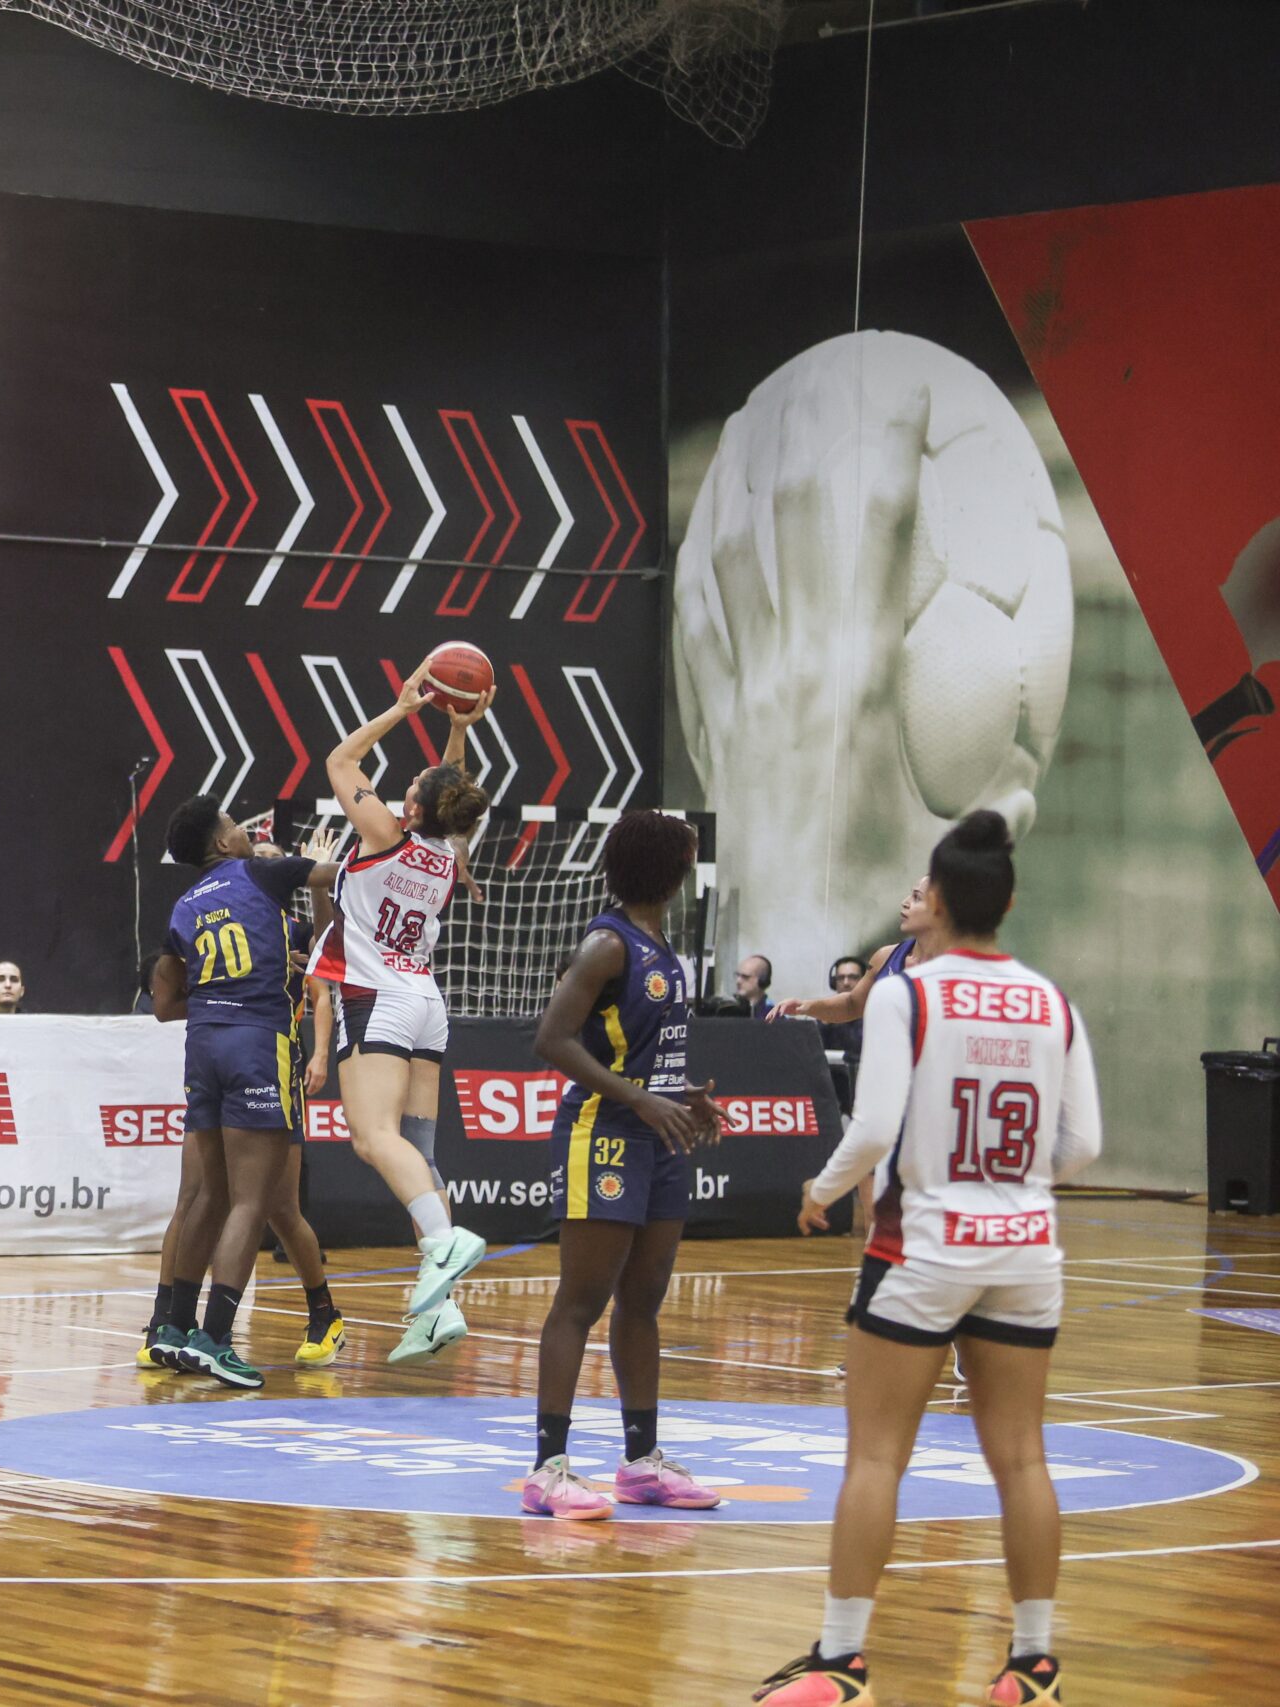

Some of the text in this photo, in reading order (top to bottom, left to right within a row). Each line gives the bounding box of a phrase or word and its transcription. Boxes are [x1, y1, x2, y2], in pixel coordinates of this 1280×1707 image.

[384, 872, 428, 900] ALINE
[205, 908, 231, 924] SOUZA
[374, 897, 426, 955] 12
[195, 922, 252, 985] 20
[952, 982, 1041, 1021] SESI
[967, 1036, 1031, 1067] MIKA
[308, 1104, 351, 1140] ES
[479, 1078, 573, 1138] SE
[727, 1100, 805, 1133] SESI
[114, 1109, 186, 1144] SES
[948, 1077, 1039, 1184] 13
[594, 1136, 626, 1167] 32
[953, 1214, 1048, 1243] FIESP
